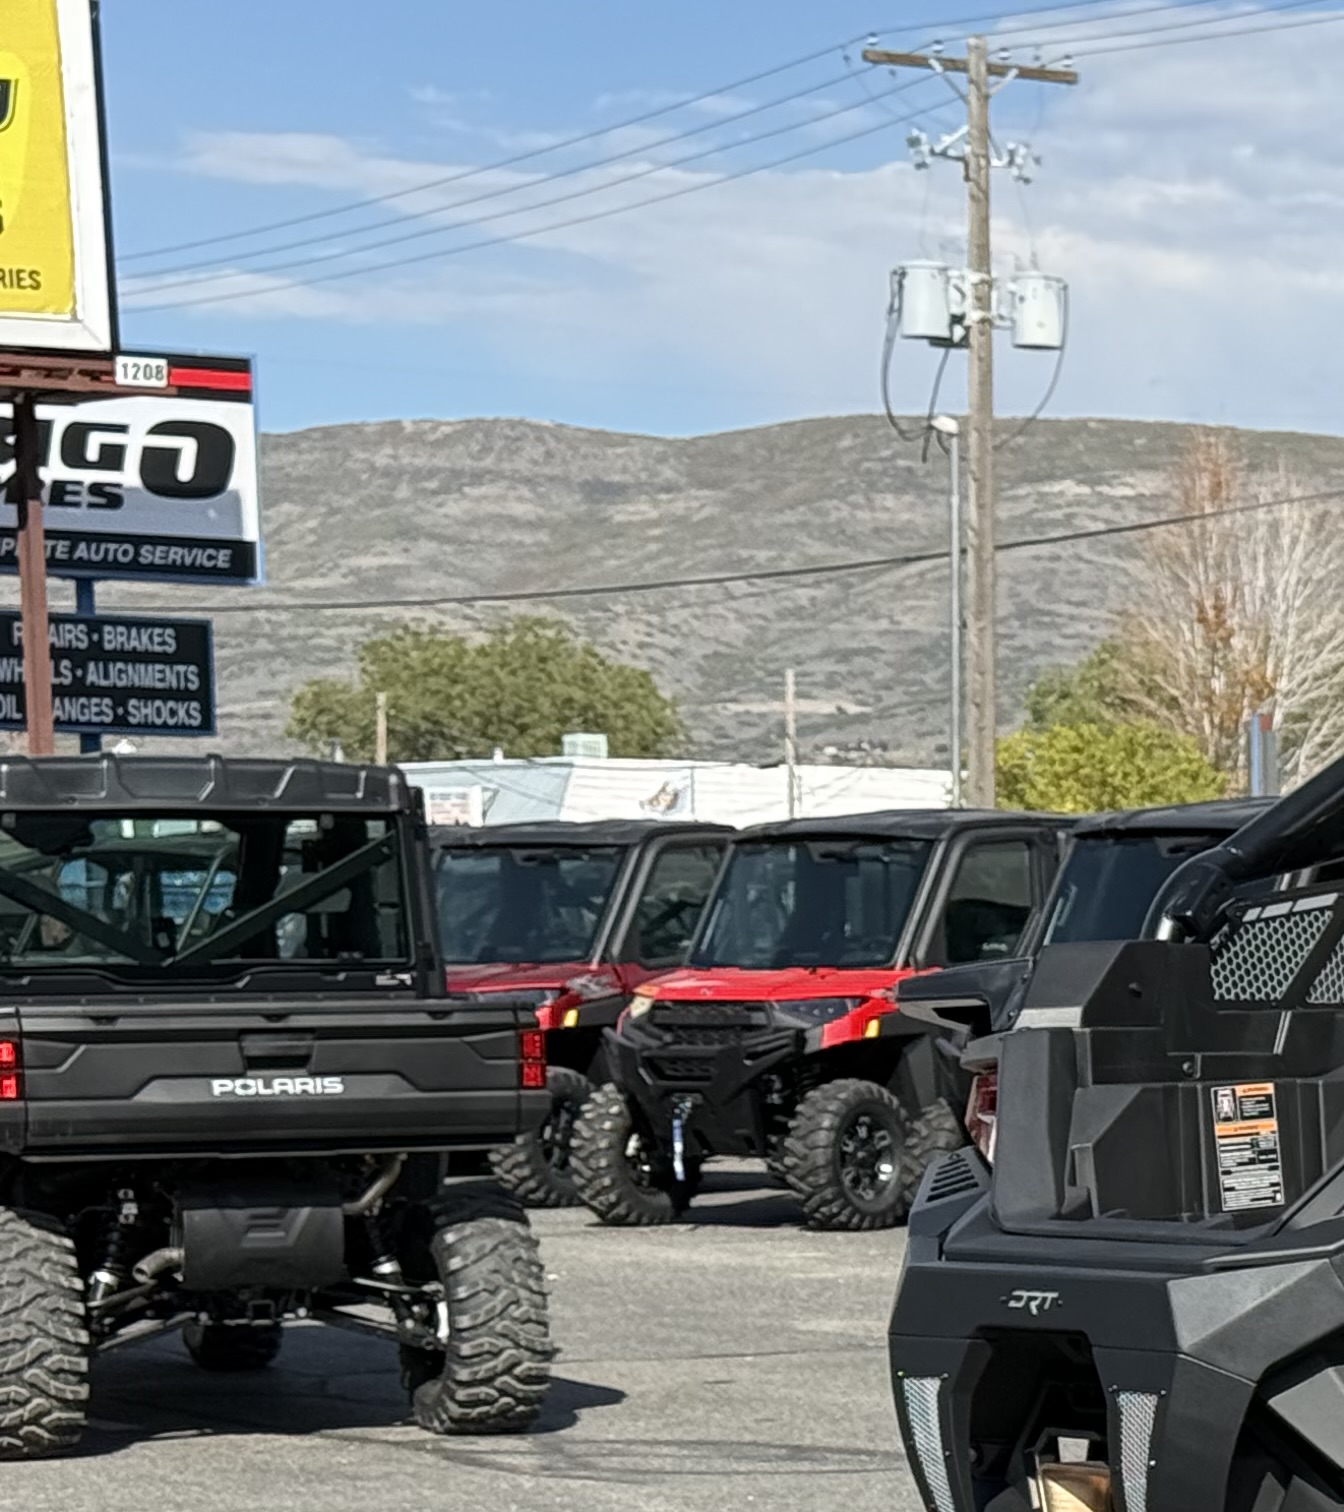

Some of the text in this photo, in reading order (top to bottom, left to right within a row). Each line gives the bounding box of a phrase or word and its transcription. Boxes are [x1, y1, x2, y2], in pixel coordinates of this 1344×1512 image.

[121, 362, 165, 382] 1208
[0, 415, 130, 472] IG
[73, 541, 135, 564] AUTO
[138, 545, 233, 569] SERVICE
[13, 621, 178, 655] RAIRS BRAKES
[0, 657, 201, 692] WHLS ALIGNMENTS
[127, 698, 202, 728] SHOCKS
[211, 1076, 345, 1097] POLARIS
